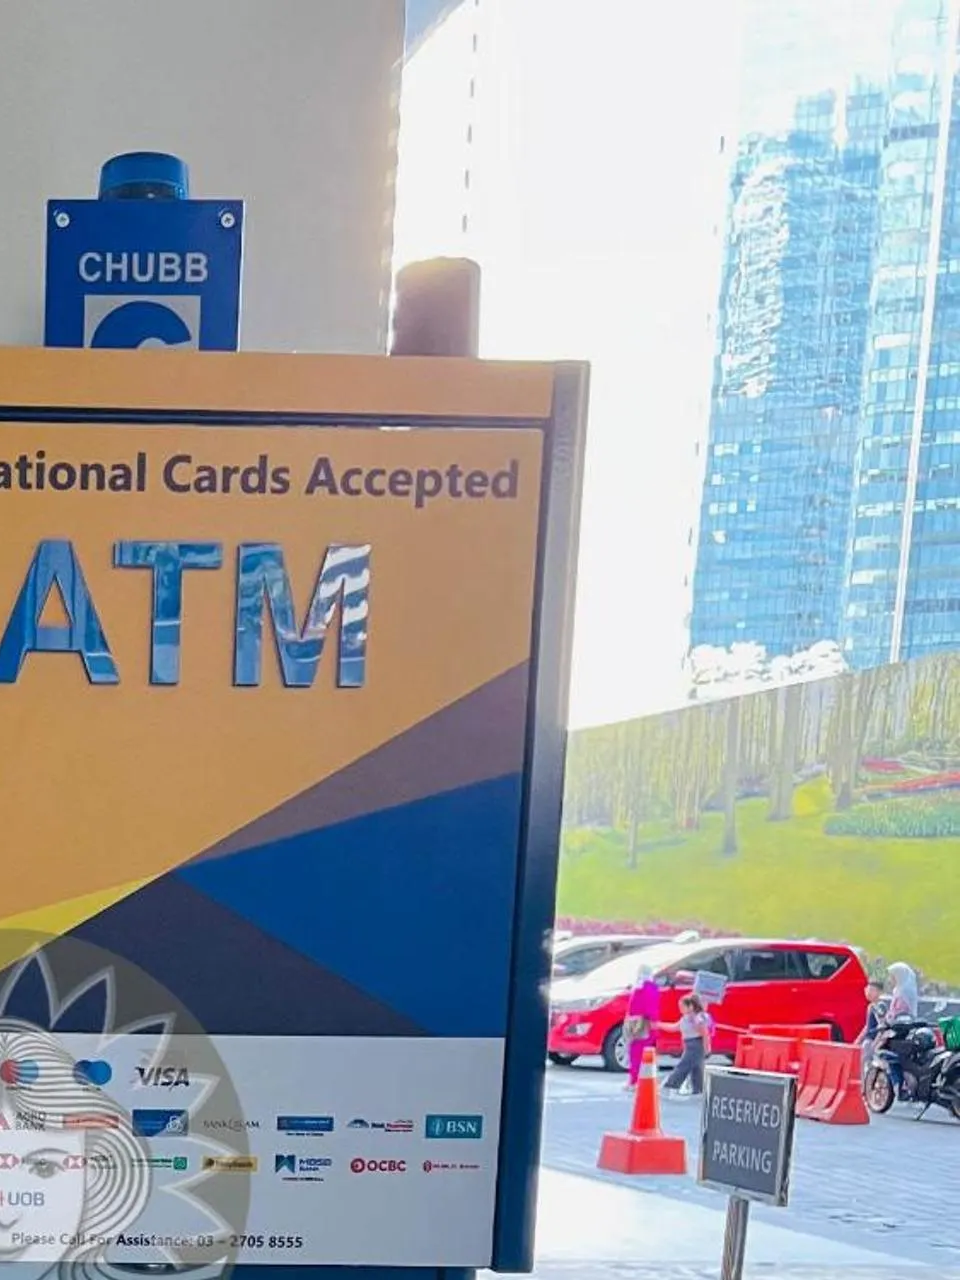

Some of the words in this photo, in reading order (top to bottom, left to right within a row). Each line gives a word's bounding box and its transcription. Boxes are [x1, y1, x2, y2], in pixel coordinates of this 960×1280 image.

[77, 251, 210, 283] CHUBB
[163, 454, 290, 496] Cards
[304, 457, 519, 508] Accepted
[135, 1066, 190, 1087] VISA
[711, 1095, 781, 1129] RESERVED
[446, 1120, 477, 1134] BSN
[367, 1160, 407, 1172] OCBC
[712, 1140, 773, 1174] PARKING
[7, 1192, 45, 1207] UOB
[11, 1232, 55, 1245] Please
[59, 1232, 85, 1246] Call
[90, 1233, 113, 1246] For
[116, 1233, 194, 1247] Assistance:
[197, 1235, 214, 1247] 03
[230, 1235, 265, 1248] 2705
[268, 1235, 304, 1248] 8555
